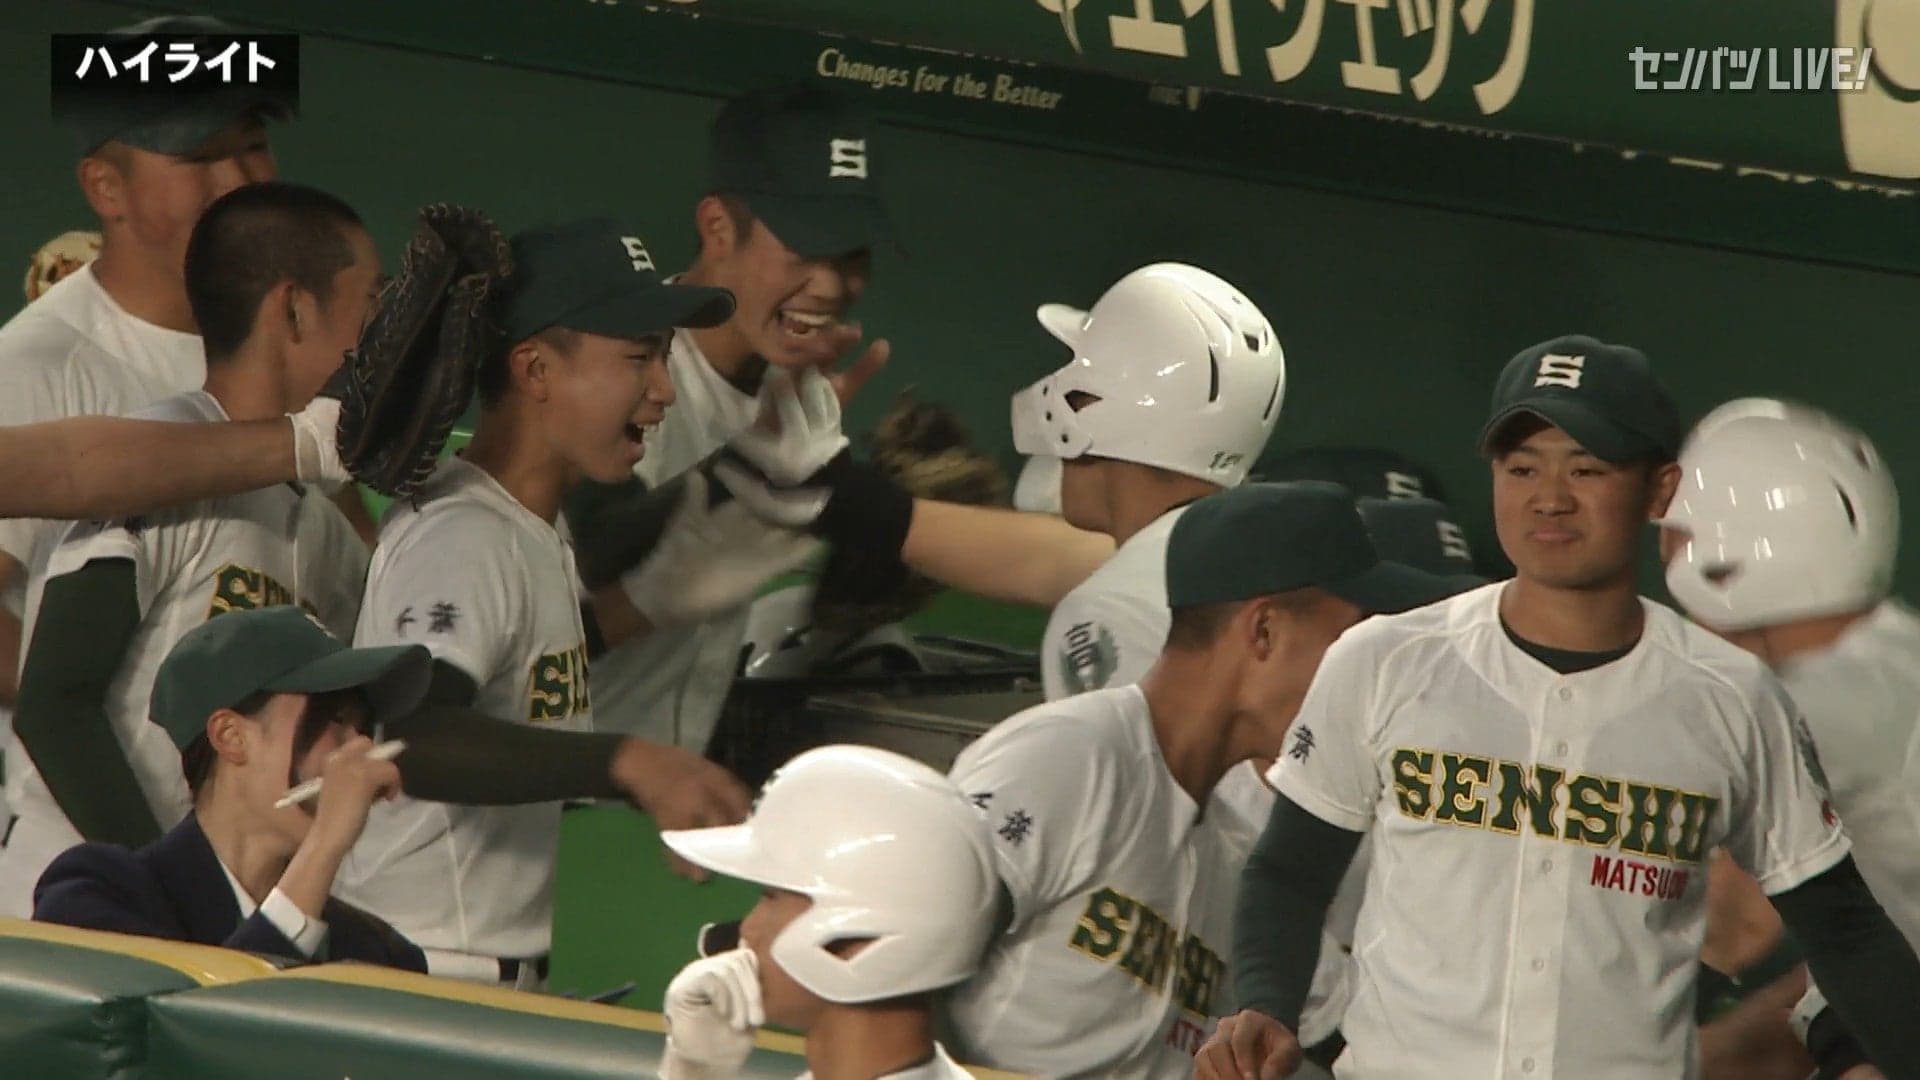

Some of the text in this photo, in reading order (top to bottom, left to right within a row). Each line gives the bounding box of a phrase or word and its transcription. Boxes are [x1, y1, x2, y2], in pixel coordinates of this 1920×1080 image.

[816, 47, 1063, 109] Changes for the Better
[829, 138, 868, 179] S
[620, 236, 655, 271] S
[1533, 353, 1585, 389] S
[1391, 748, 1720, 865] SENSHU
